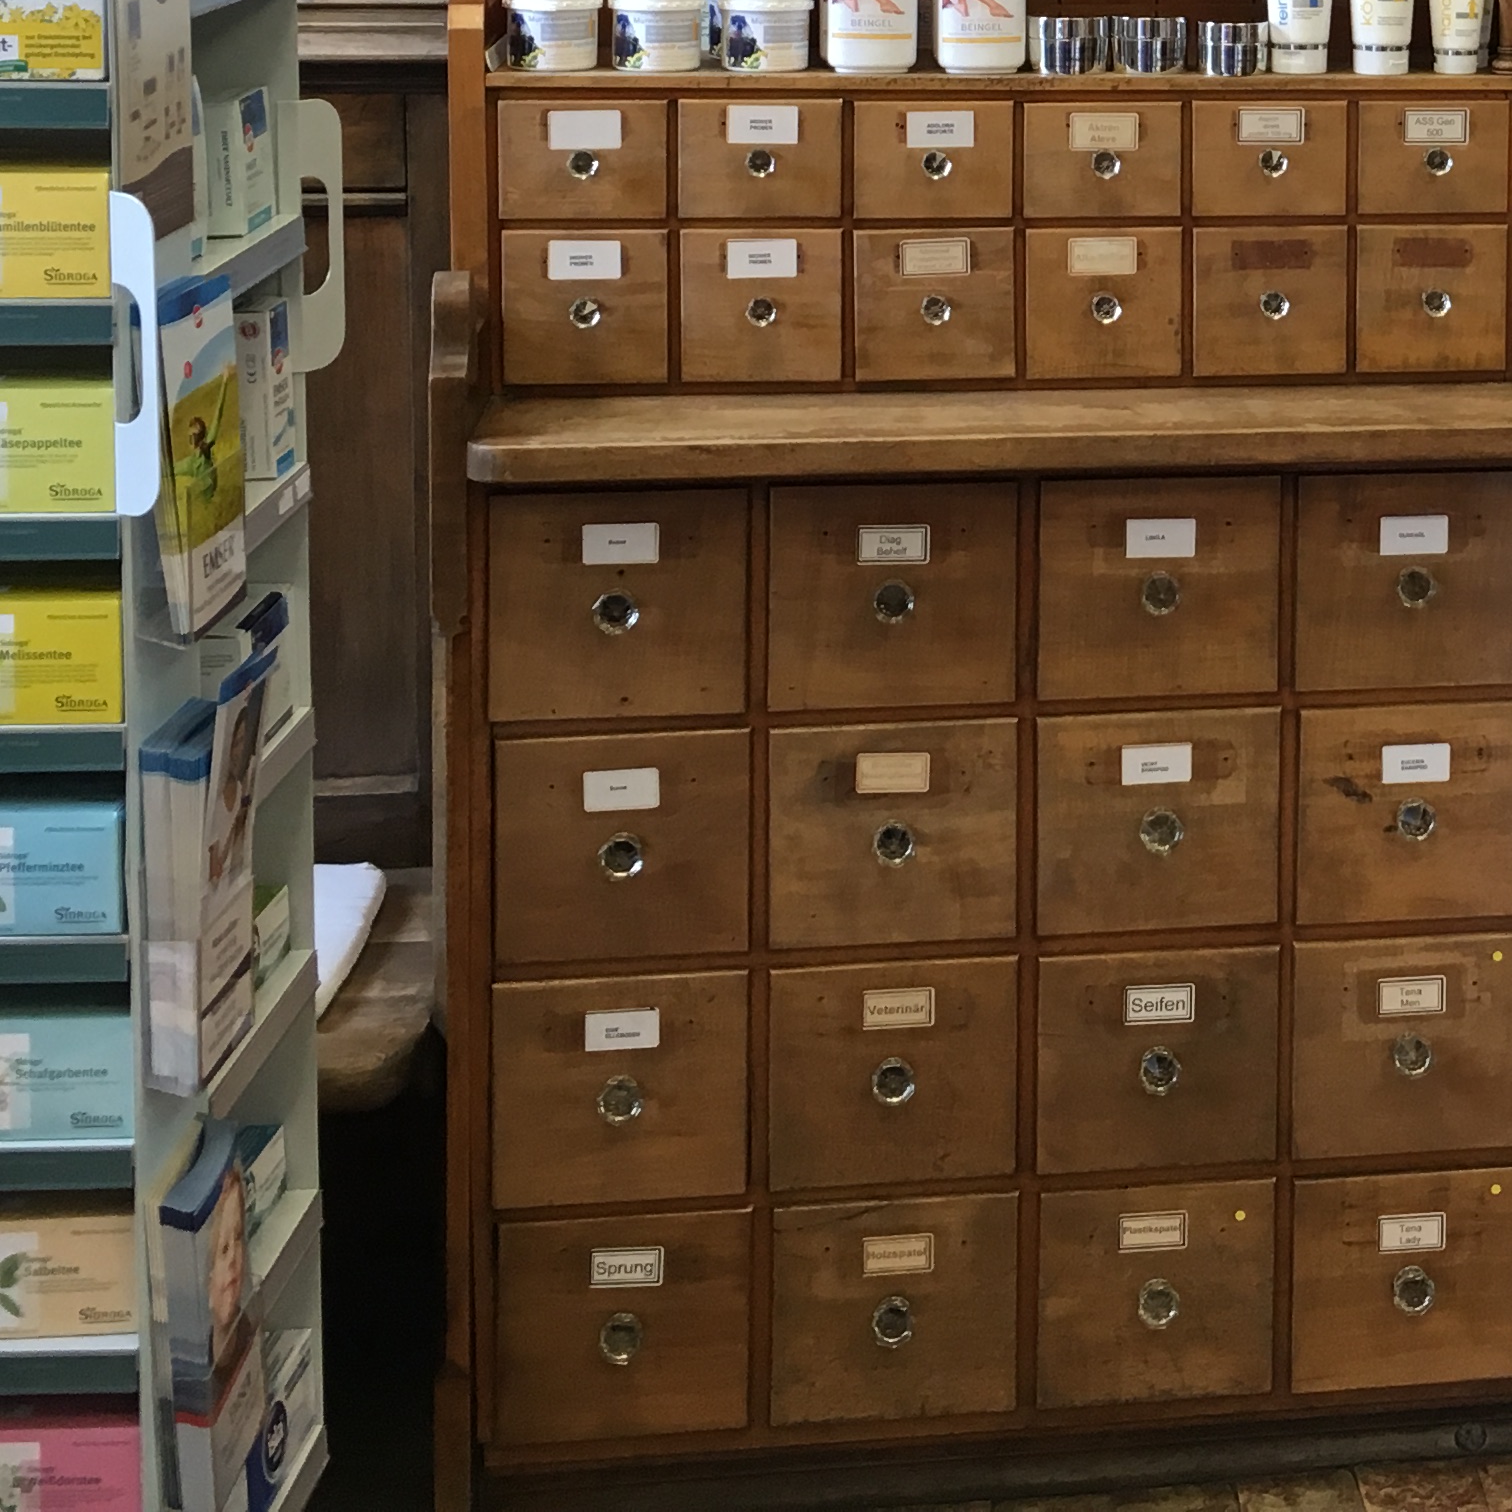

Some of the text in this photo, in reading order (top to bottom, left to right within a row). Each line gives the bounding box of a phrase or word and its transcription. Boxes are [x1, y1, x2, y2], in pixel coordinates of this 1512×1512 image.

[851, 19, 892, 27] BEINGEL
[961, 23, 1002, 31] BEINGEL
[1088, 123, 1119, 132] Aktren
[1415, 118, 1455, 126] ASS Gen
[1427, 128, 1443, 136] 500
[1090, 134, 1117, 143] Aleve
[44, 267, 97, 282] SIDROGA
[49, 483, 103, 497] SIDROGA
[879, 535, 901, 545] Diag
[877, 546, 906, 555] Behelf
[0, 649, 71, 661] Melissentee
[55, 694, 108, 709] SIDROGA
[0, 861, 84, 872] Pfefferminztee
[55, 907, 106, 920] SIDROGA
[1400, 987, 1422, 995] Tena
[1132, 996, 1185, 1013] Seifen
[1401, 999, 1420, 1007] Men
[868, 1003, 925, 1015] Veterinär
[15, 1066, 108, 1079] Schafgarbentee
[70, 1111, 123, 1125] SIDROGA
[1123, 1225, 1180, 1235] Plastikspatel
[1400, 1236, 1420, 1245] Lady
[867, 1249, 926, 1260] Holzspatel
[24, 1264, 80, 1275] Salbeitee
[596, 1261, 654, 1276] Sprung
